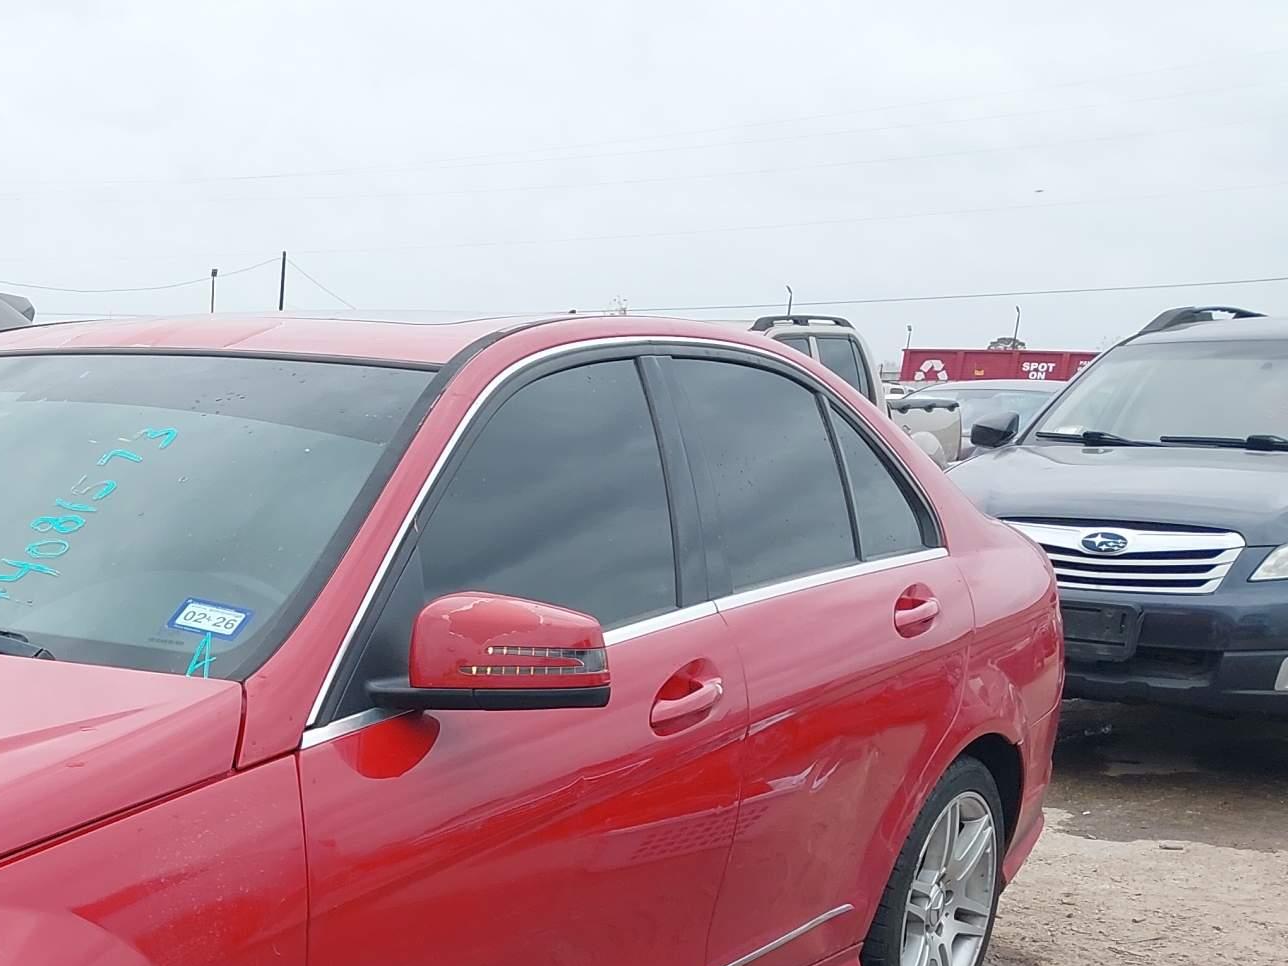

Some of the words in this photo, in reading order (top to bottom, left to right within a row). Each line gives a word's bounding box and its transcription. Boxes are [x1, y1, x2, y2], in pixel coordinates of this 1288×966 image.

[1022, 362, 1055, 372] SPOT
[1028, 371, 1046, 379] ON
[185, 631, 216, 679] A
